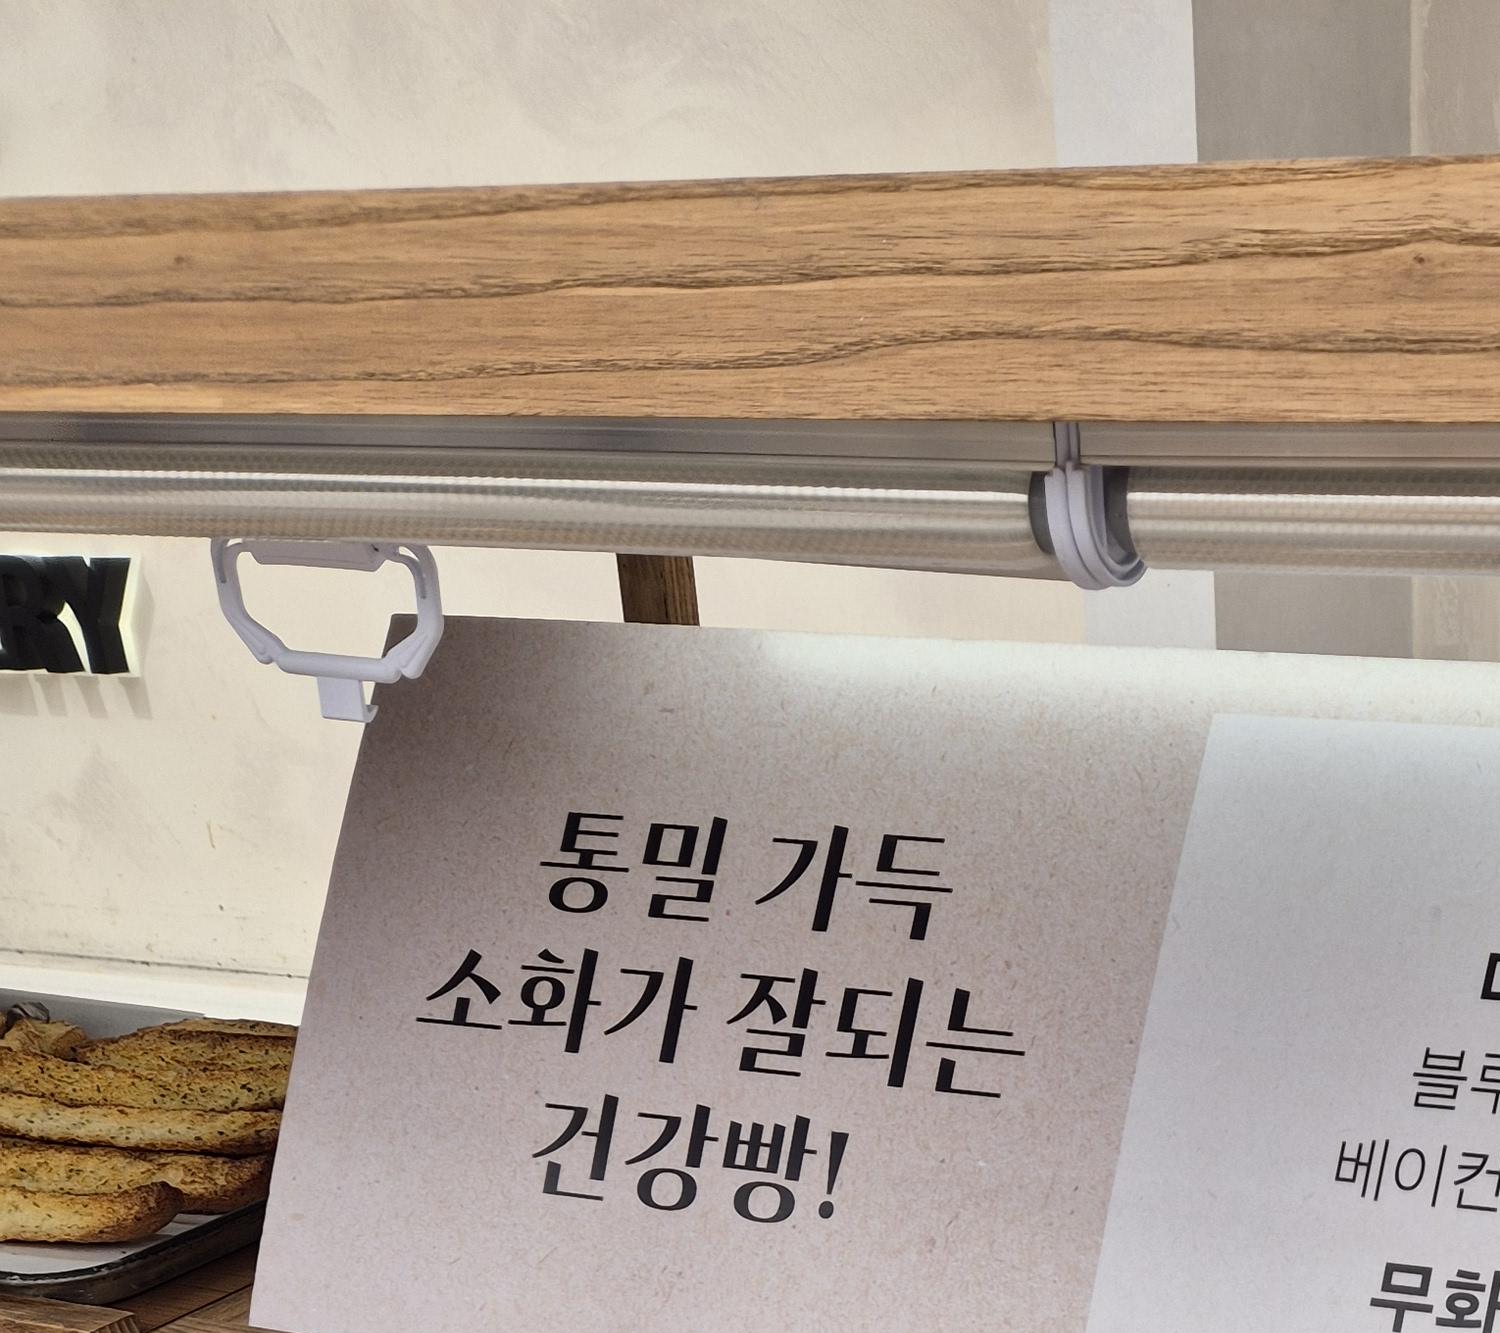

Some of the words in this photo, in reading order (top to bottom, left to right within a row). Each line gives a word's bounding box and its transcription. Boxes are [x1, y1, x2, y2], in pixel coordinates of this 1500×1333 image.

[540, 812, 728, 922] 통밀
[755, 825, 953, 940] 가득
[416, 948, 697, 1063] 소화가
[727, 968, 1025, 1098] 잘되는
[532, 1091, 849, 1223] 건강빵!
